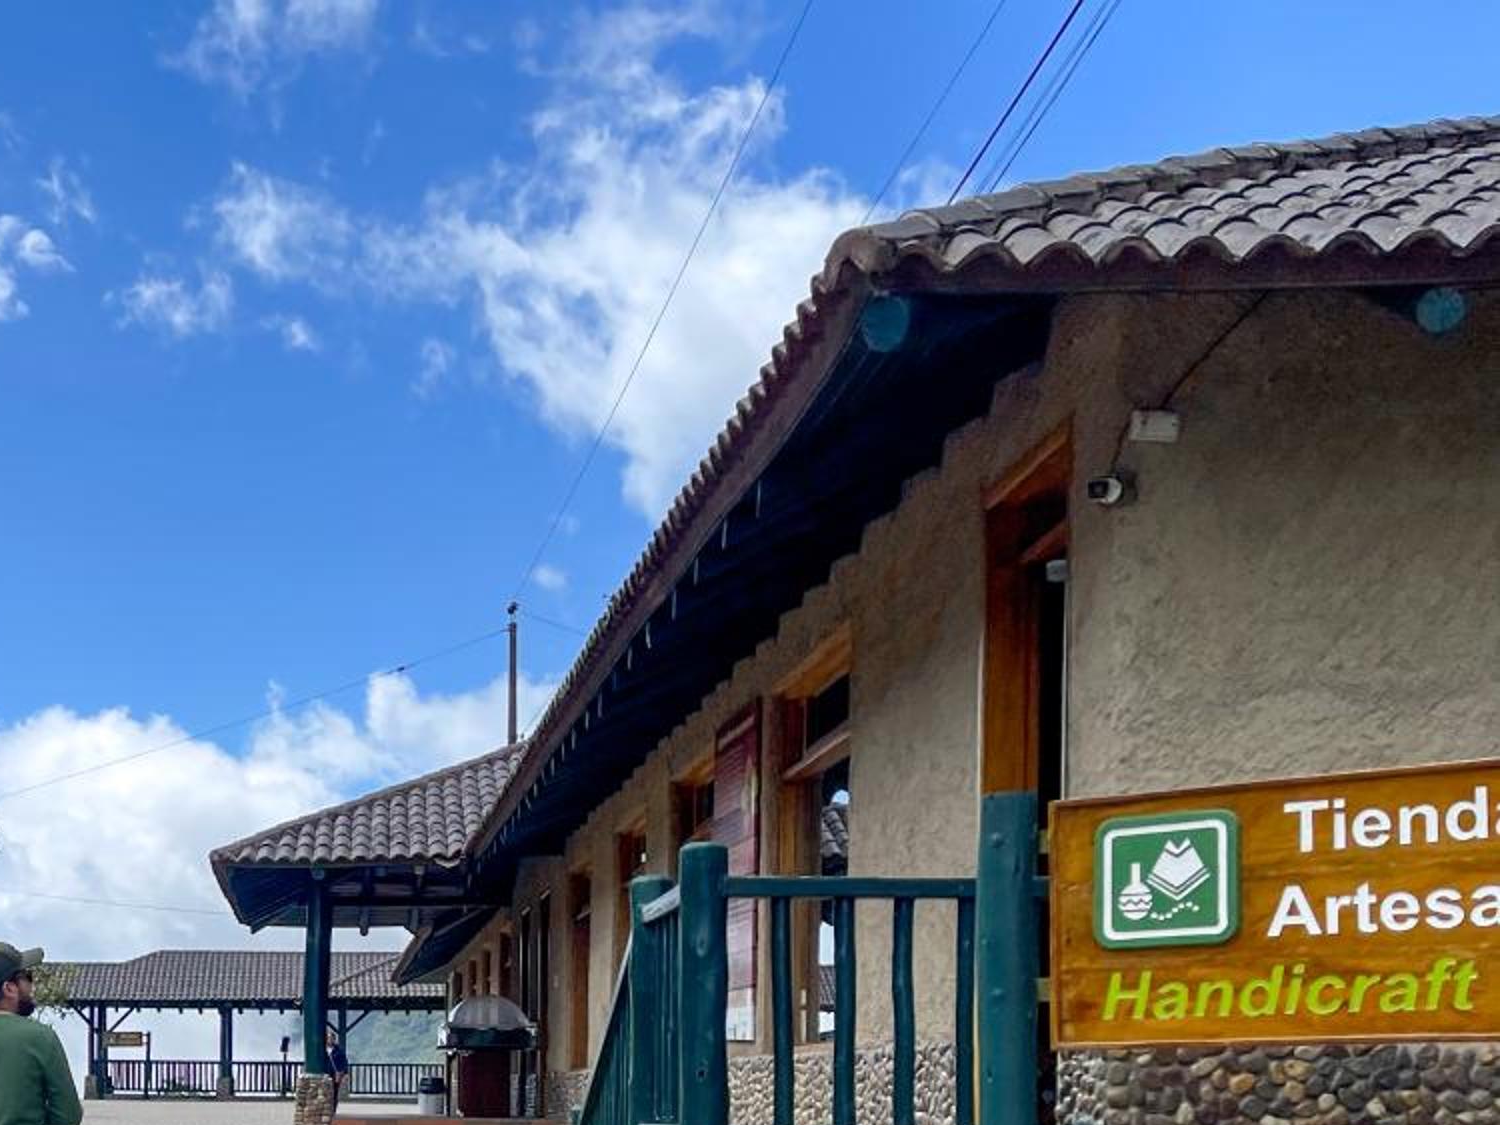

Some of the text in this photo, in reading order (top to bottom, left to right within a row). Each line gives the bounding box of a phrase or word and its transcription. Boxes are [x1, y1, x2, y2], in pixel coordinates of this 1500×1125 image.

[1283, 785, 1500, 853] Tiend
[1266, 881, 1500, 937] Artesa
[1102, 957, 1478, 1021] Handicraft
